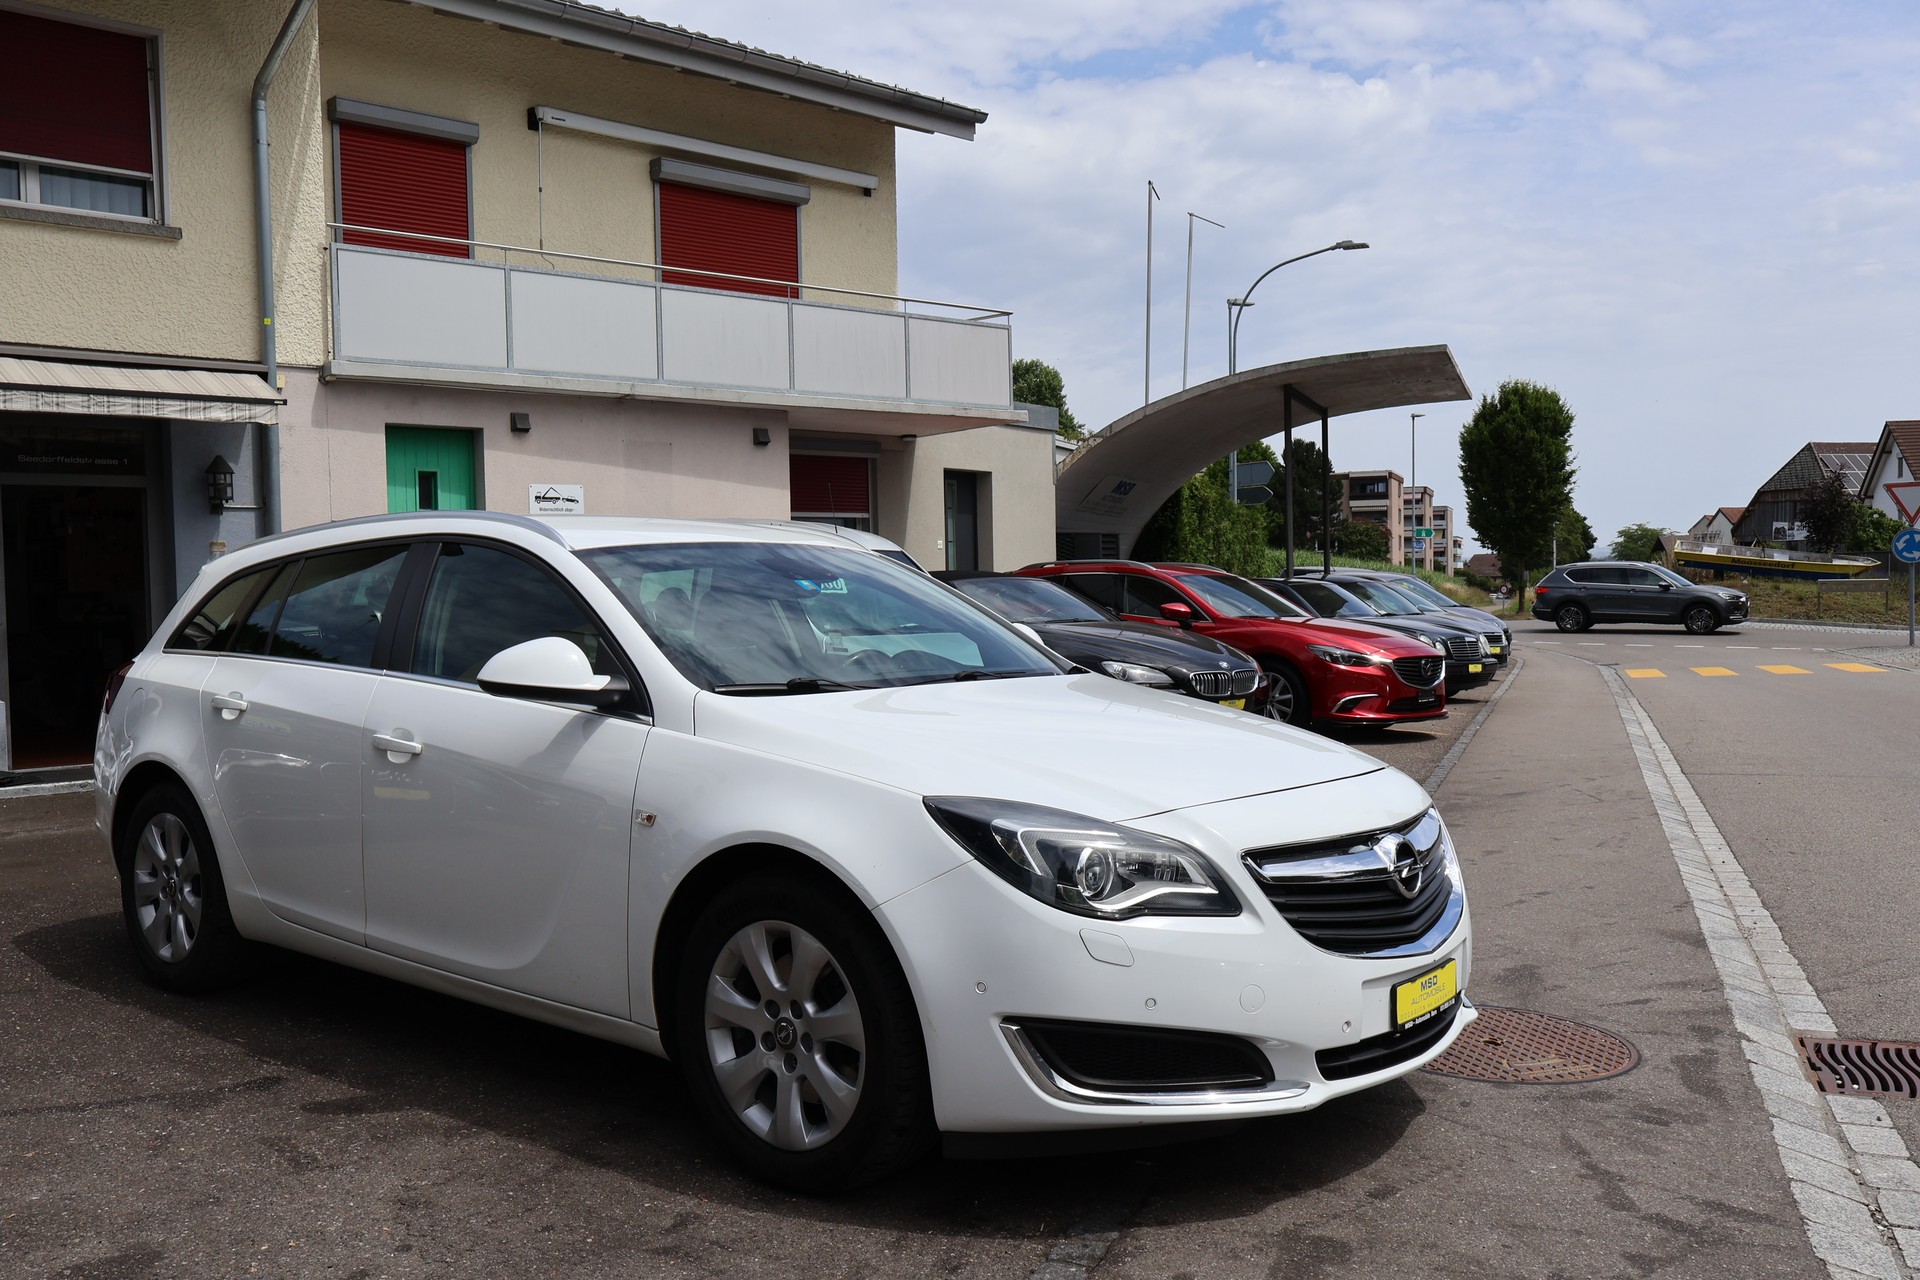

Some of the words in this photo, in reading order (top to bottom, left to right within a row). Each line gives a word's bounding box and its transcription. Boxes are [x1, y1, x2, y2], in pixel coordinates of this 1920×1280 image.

[1111, 480, 1136, 496] MSD
[1731, 558, 1796, 569] Moosseedorf
[1420, 975, 1438, 992] MSD
[1411, 982, 1446, 1005] AUTOMOBILE
